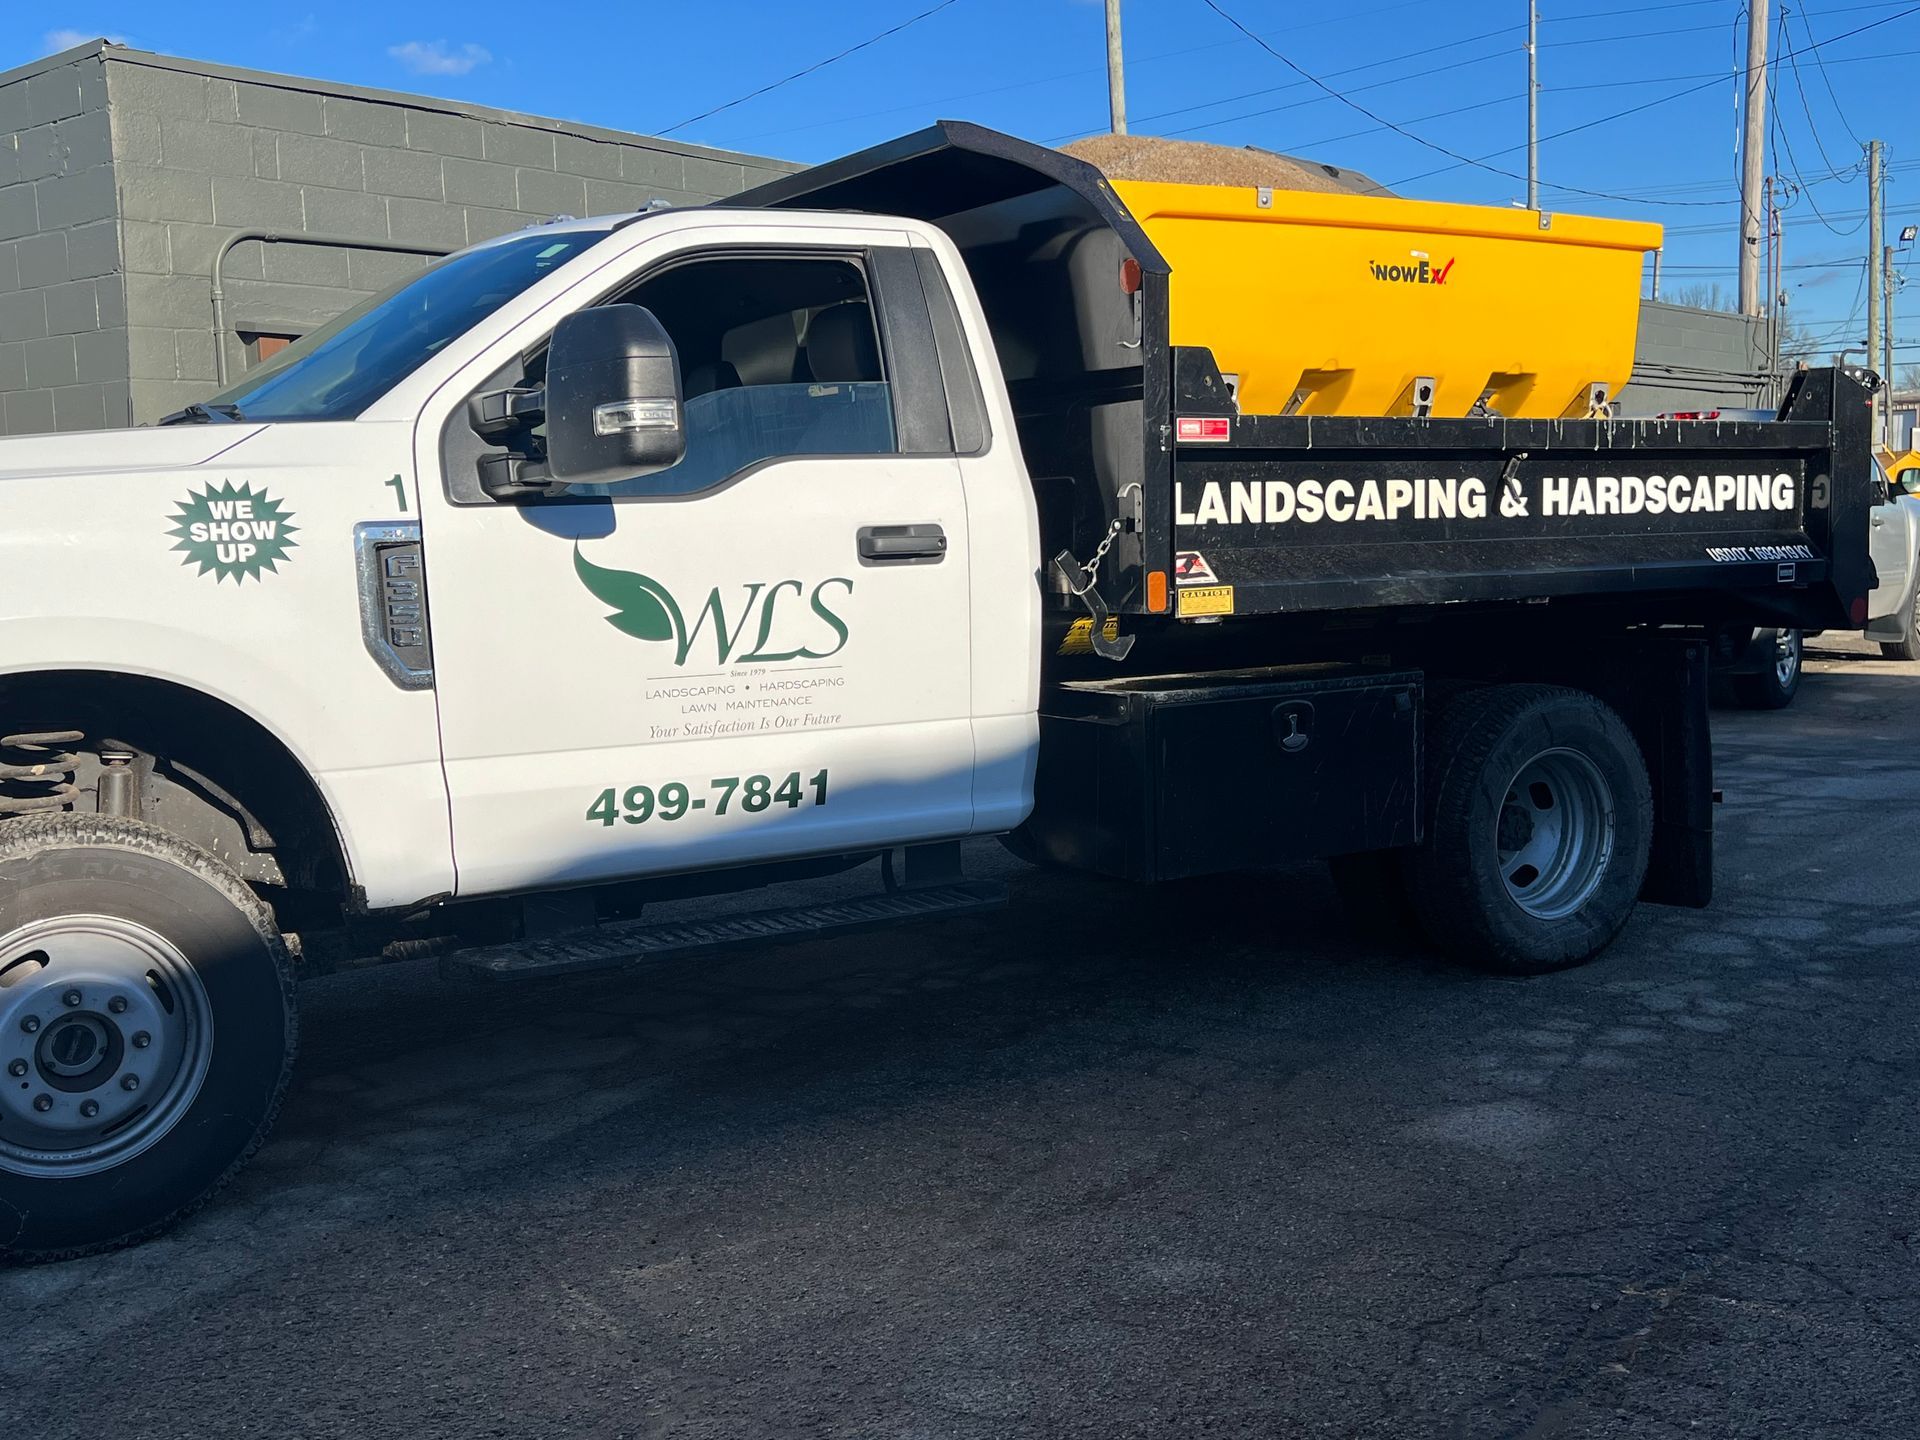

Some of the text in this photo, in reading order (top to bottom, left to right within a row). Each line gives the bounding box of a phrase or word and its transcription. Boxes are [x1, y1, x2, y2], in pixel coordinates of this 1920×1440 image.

[384, 473, 408, 512] 1
[1175, 477, 1487, 526] LANDSCAPING
[1499, 477, 1530, 518] &
[1542, 473, 1795, 516] HARDSCAPING
[207, 500, 254, 520] WE
[189, 520, 277, 543] SHOW
[215, 543, 257, 564] UP
[1705, 547, 1752, 562] USDOT
[640, 577, 854, 667] WLS
[730, 668, 766, 678] Since 1979
[645, 677, 845, 700] LANDSCAPING HARDSCAPING
[681, 696, 813, 714] LAWN MAINTENANCE
[649, 712, 842, 739] Your Satisfaction Is Our Future
[586, 768, 829, 827] 499-7841
